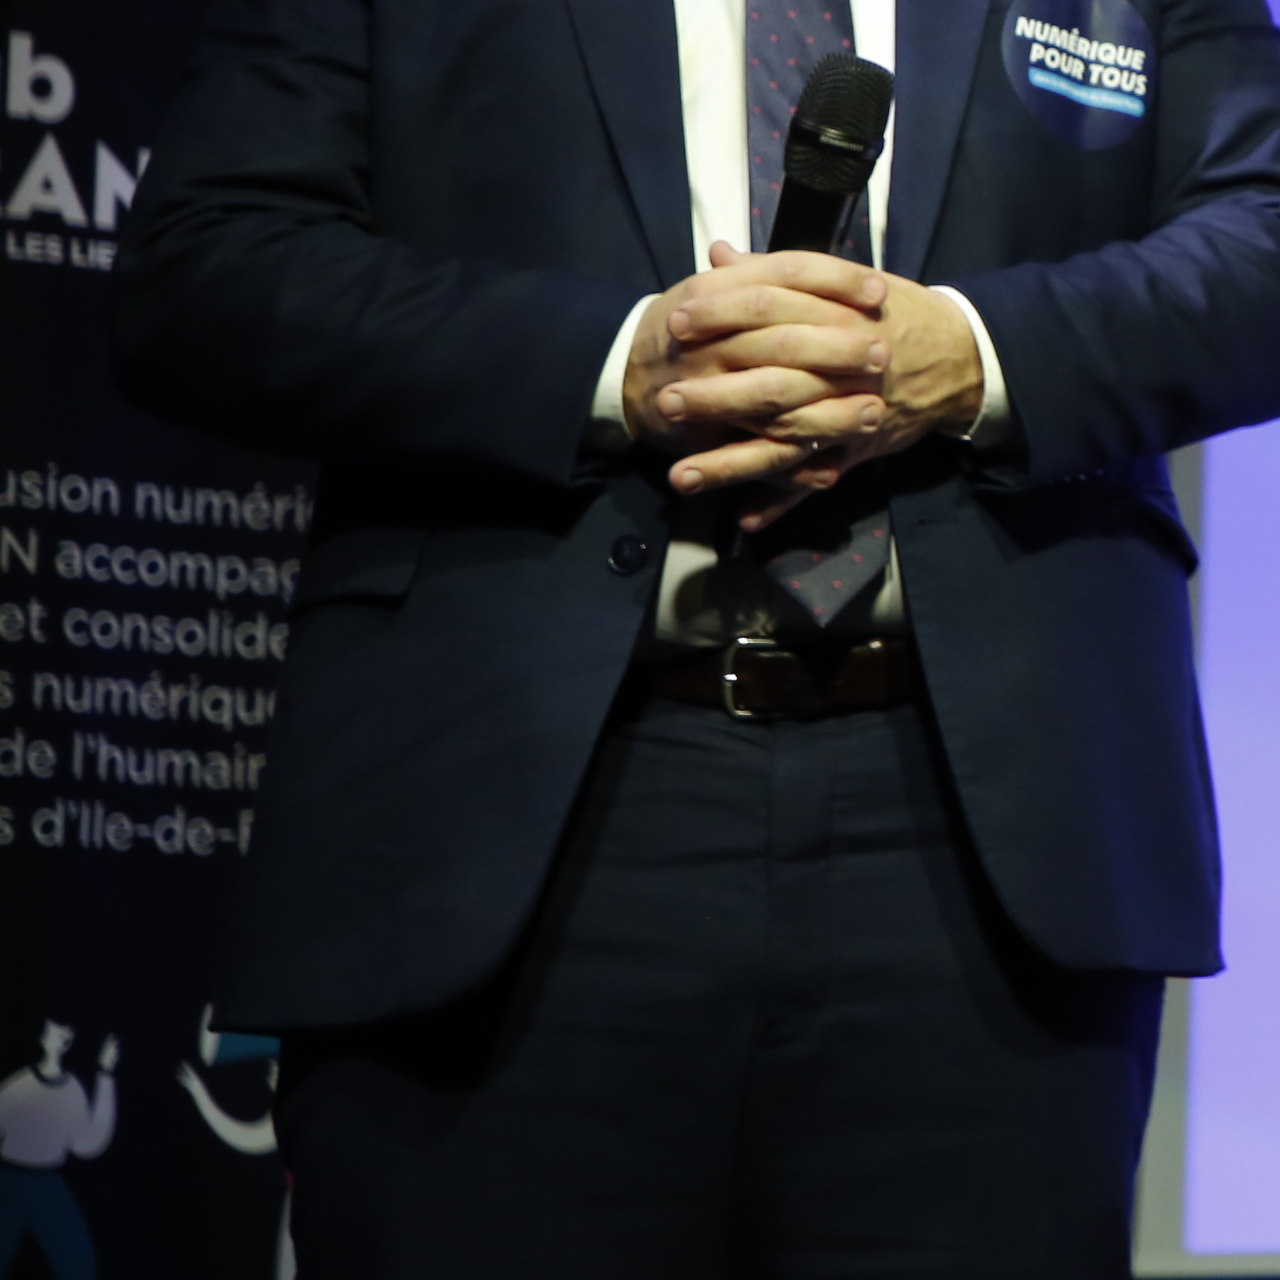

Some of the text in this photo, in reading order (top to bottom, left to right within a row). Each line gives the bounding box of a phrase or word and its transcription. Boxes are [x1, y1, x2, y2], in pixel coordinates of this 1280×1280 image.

[1015, 16, 1146, 71] NUMÉRIQUE
[1029, 42, 1085, 80] POUR
[1089, 63, 1148, 96] TOUS
[6, 230, 64, 265] LES
[135, 481, 313, 533] numéri
[32, 669, 277, 733] numériqu
